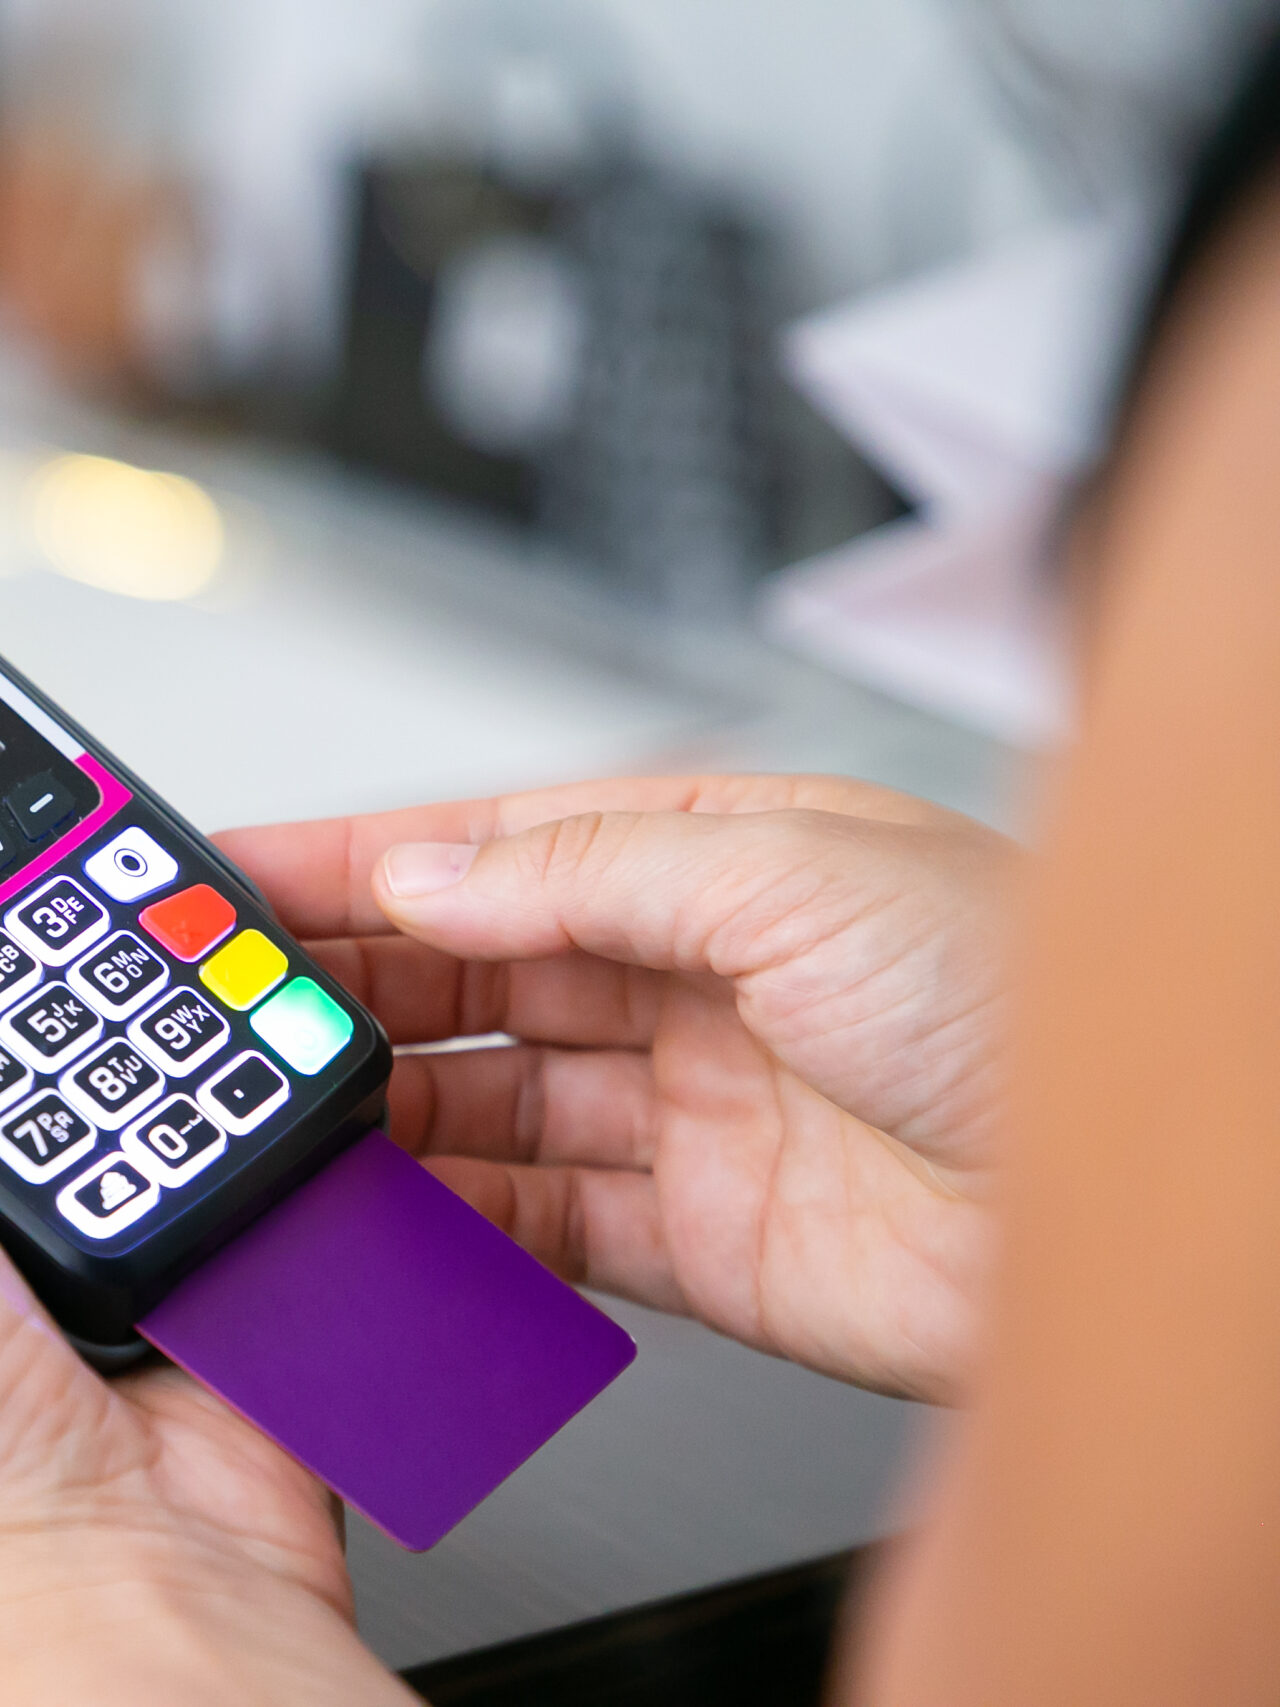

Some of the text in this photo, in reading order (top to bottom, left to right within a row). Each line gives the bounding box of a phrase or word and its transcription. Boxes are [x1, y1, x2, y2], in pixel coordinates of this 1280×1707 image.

[32, 906, 69, 938] 3
[93, 962, 130, 993] 6
[27, 1009, 67, 1043] 5
[154, 1017, 192, 1050] 9
[88, 1066, 127, 1101] 8
[13, 1119, 49, 1157] 7
[148, 1123, 188, 1159] 0
